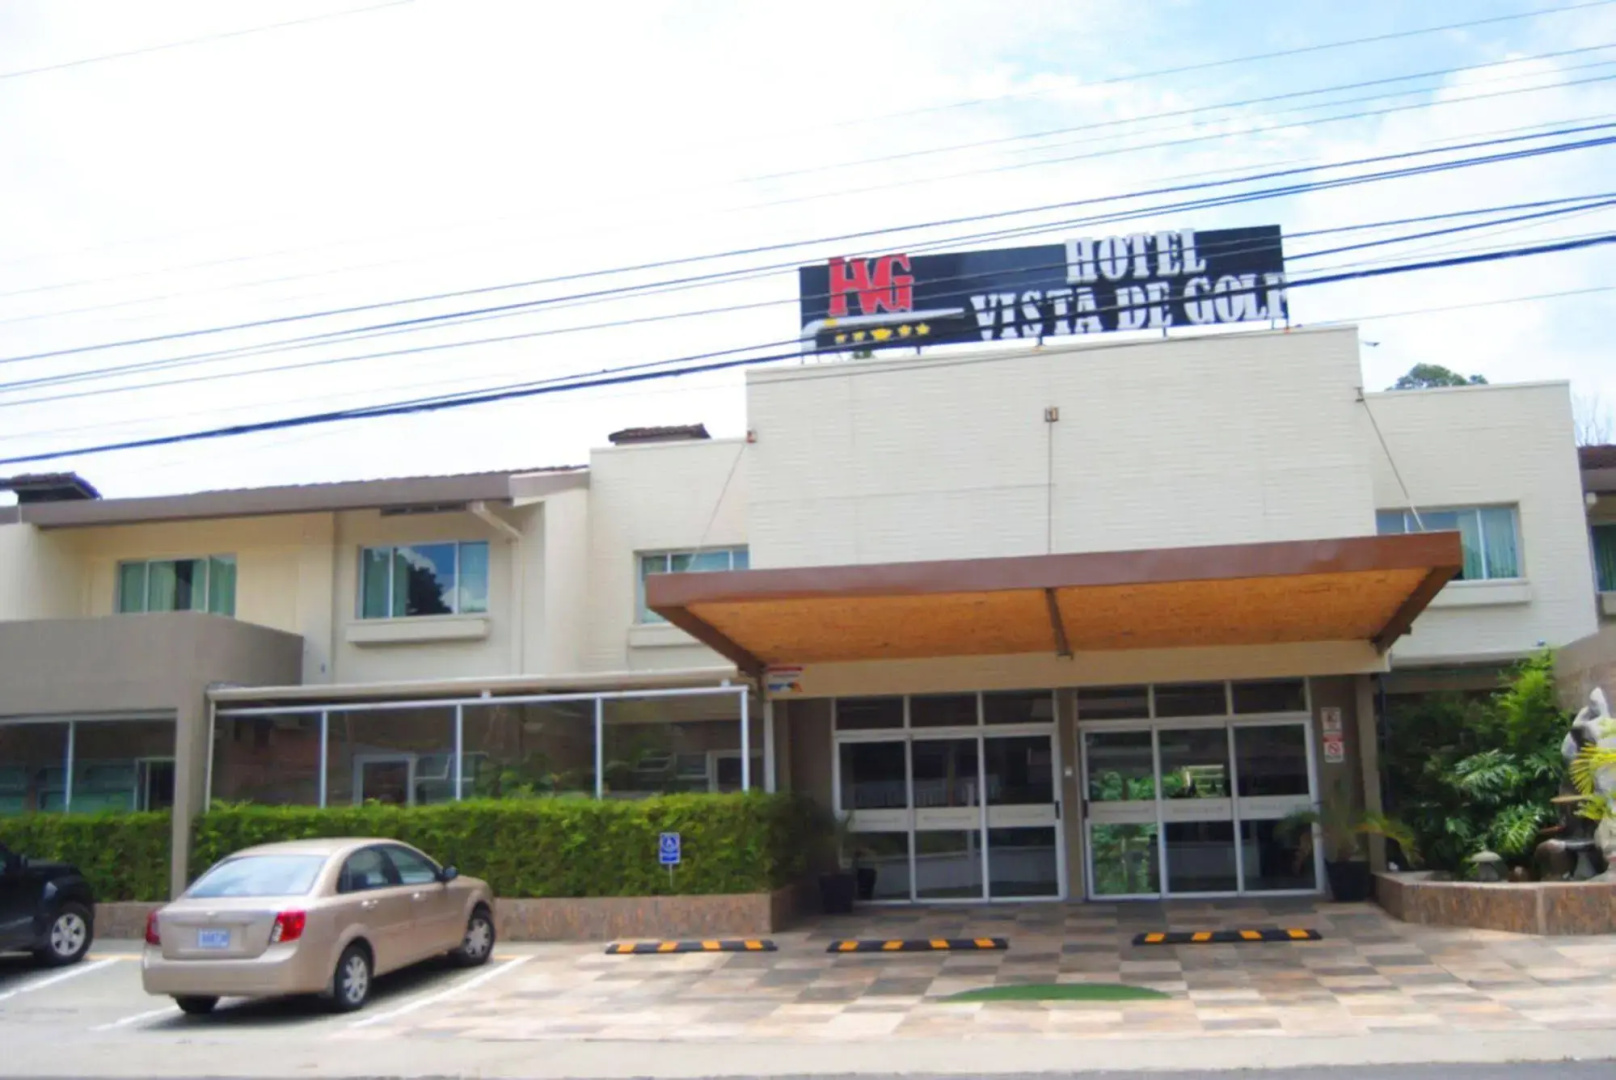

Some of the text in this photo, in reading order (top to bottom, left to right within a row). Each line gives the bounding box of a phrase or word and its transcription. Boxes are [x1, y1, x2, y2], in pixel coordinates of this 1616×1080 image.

[1065, 229, 1206, 285] HOTEL
[970, 272, 1288, 341] VISTA DE GOLF
